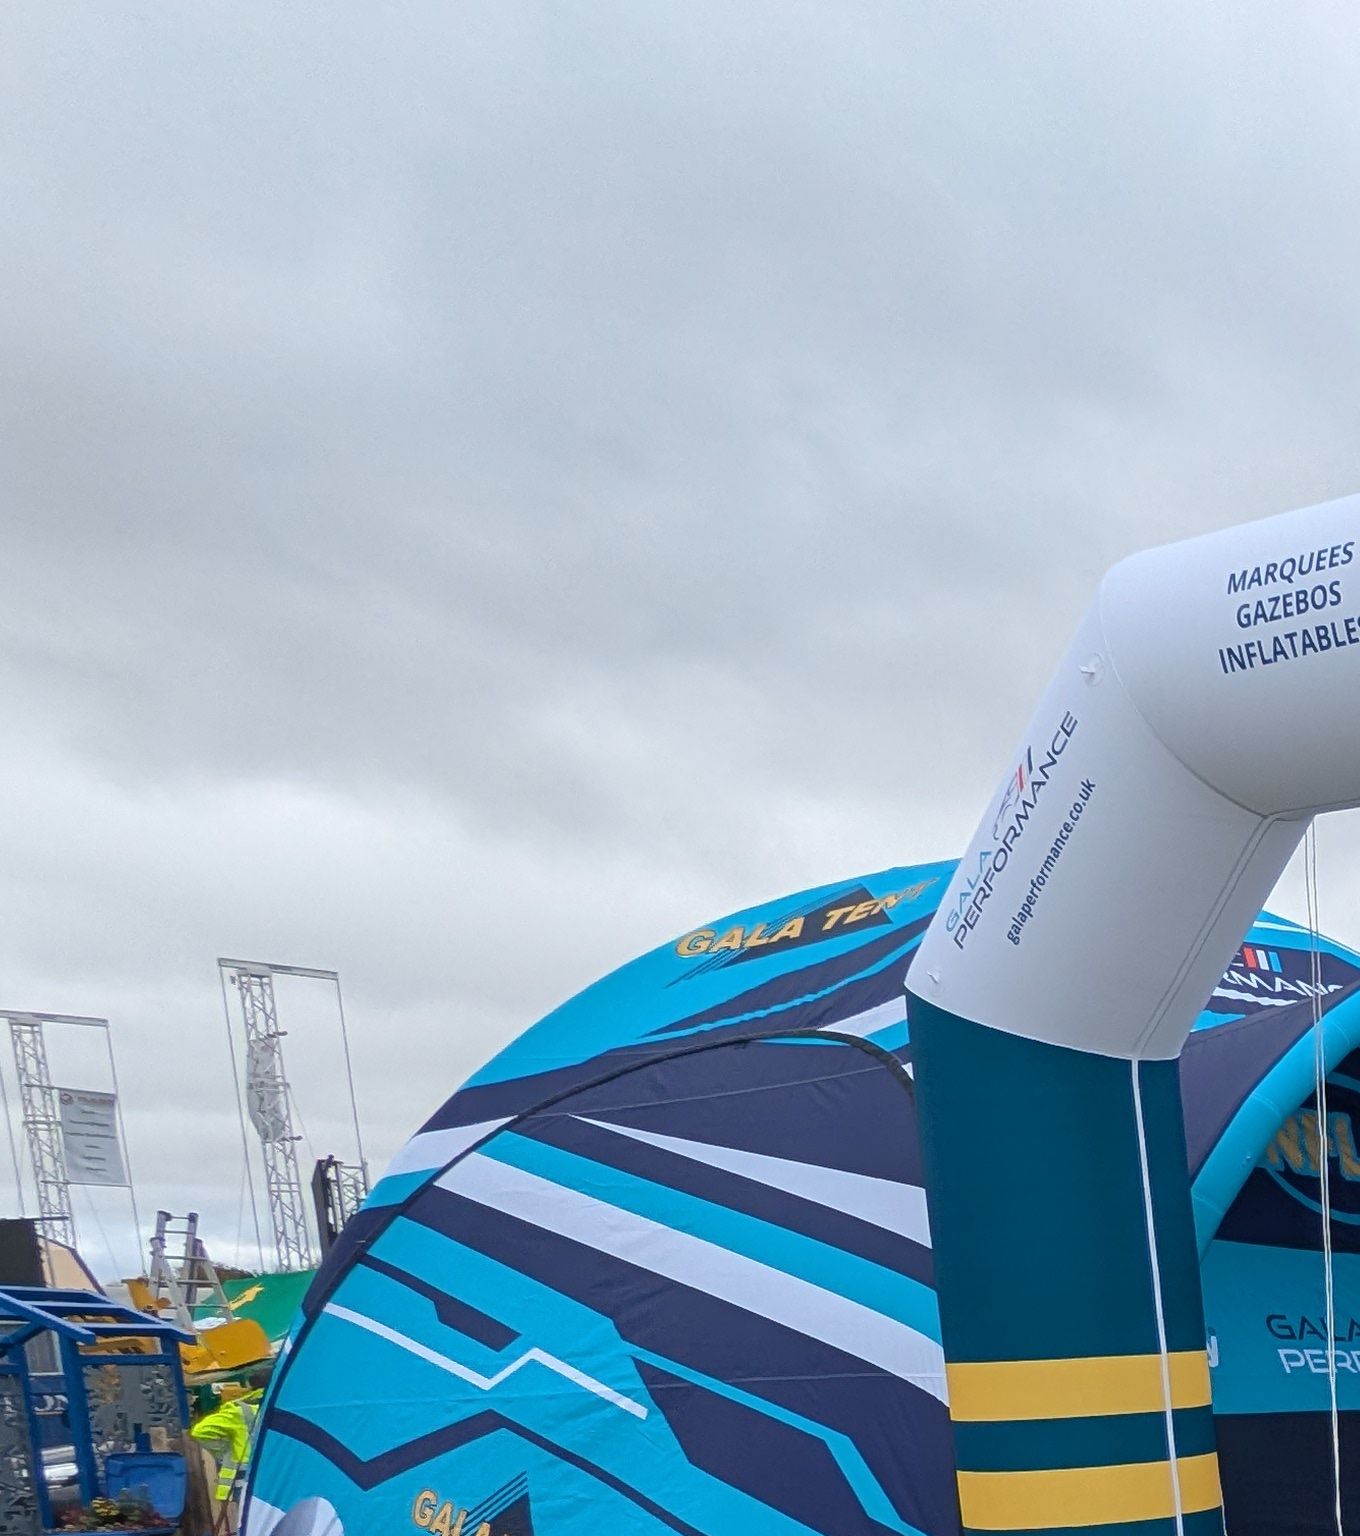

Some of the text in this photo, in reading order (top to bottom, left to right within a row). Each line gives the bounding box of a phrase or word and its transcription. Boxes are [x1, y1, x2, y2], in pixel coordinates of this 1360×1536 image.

[1227, 541, 1355, 595] MARQUEES
[1236, 580, 1342, 630] GAZEBOS
[953, 710, 1078, 950] PERFORMANCE
[1006, 778, 1097, 946] galaperformance.co.uk
[945, 850, 992, 932] GALA
[674, 916, 805, 957] GALA
